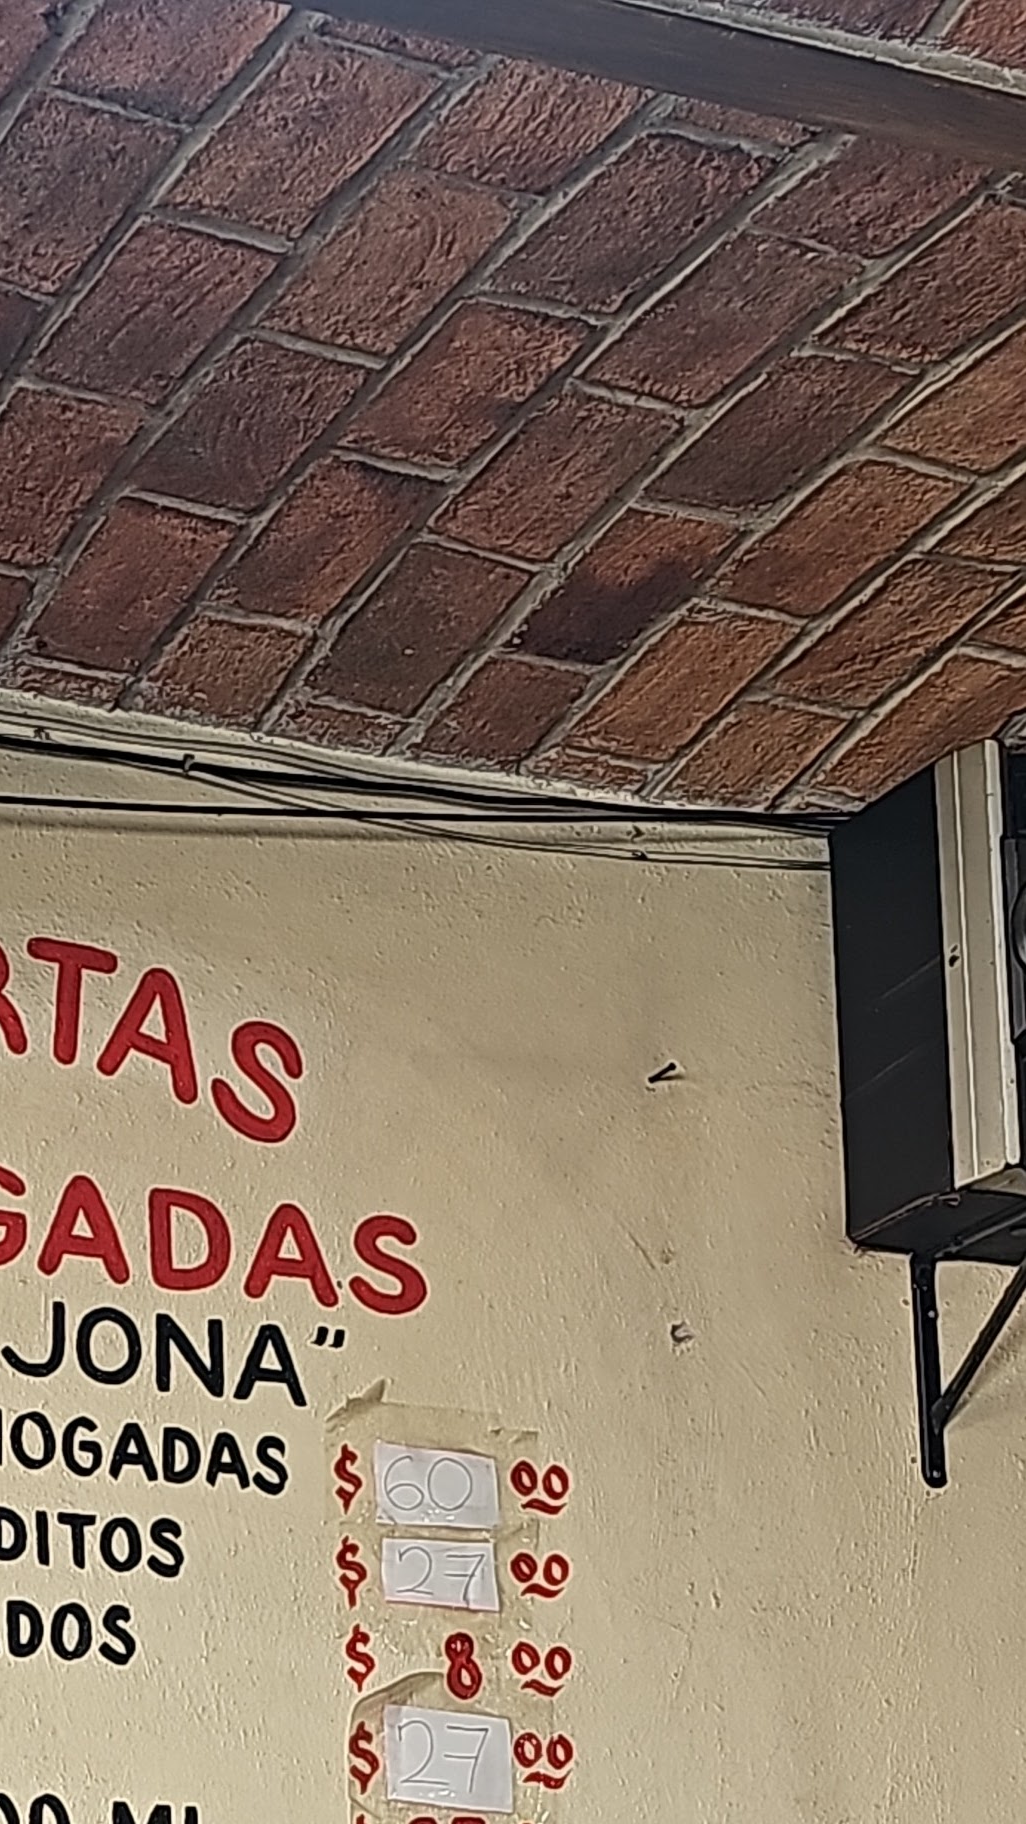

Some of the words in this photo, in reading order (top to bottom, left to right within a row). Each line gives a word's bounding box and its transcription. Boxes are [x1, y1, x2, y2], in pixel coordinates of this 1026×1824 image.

[384, 1455, 473, 1512] 60
[395, 1545, 486, 1607] 27
[444, 1632, 483, 1700] 8
[396, 1720, 490, 1794] 27
